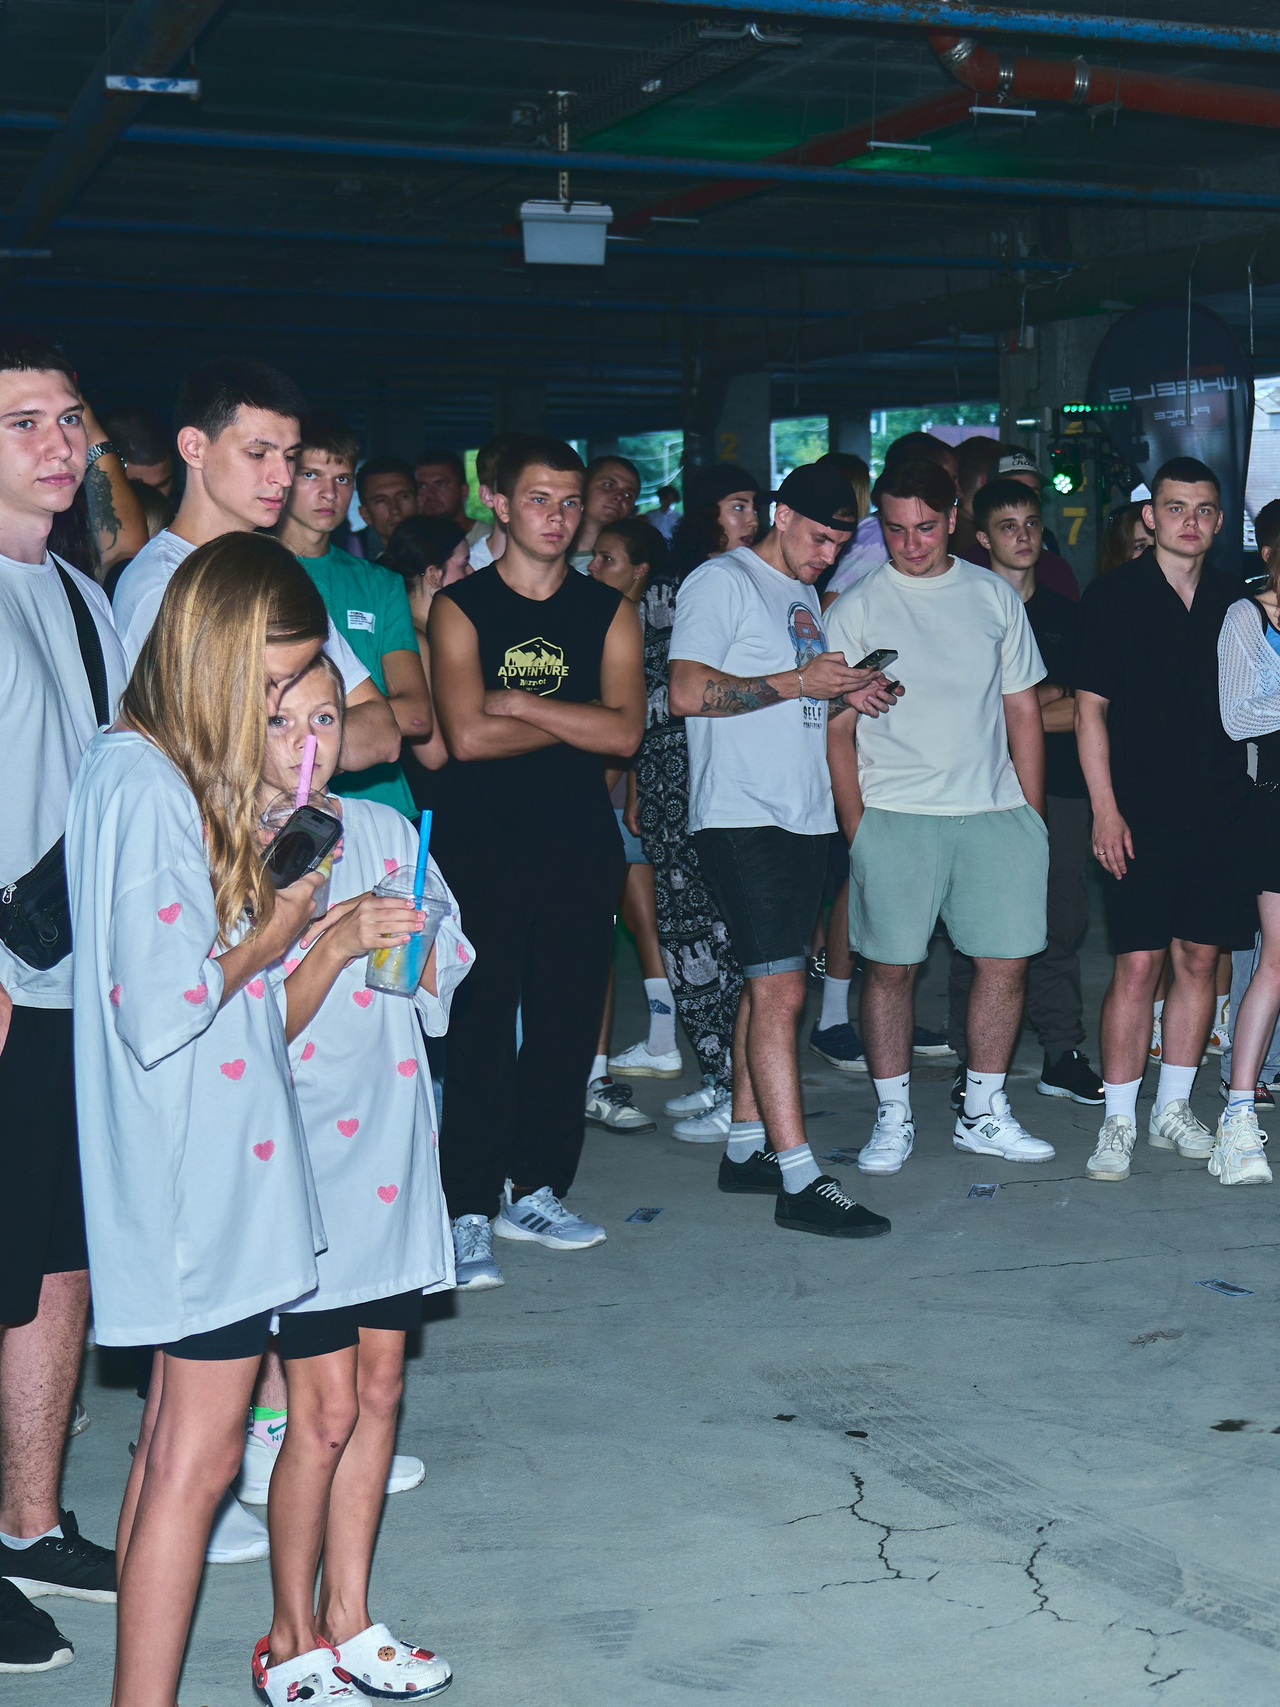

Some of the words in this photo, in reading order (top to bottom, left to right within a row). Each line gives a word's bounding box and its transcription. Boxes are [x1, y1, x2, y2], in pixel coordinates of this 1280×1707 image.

[720, 432, 738, 460] 2
[1063, 507, 1087, 545] 7
[497, 666, 570, 677] ADVENTURE
[803, 705, 822, 721] SELF
[272, 1434, 283, 1442] NI
